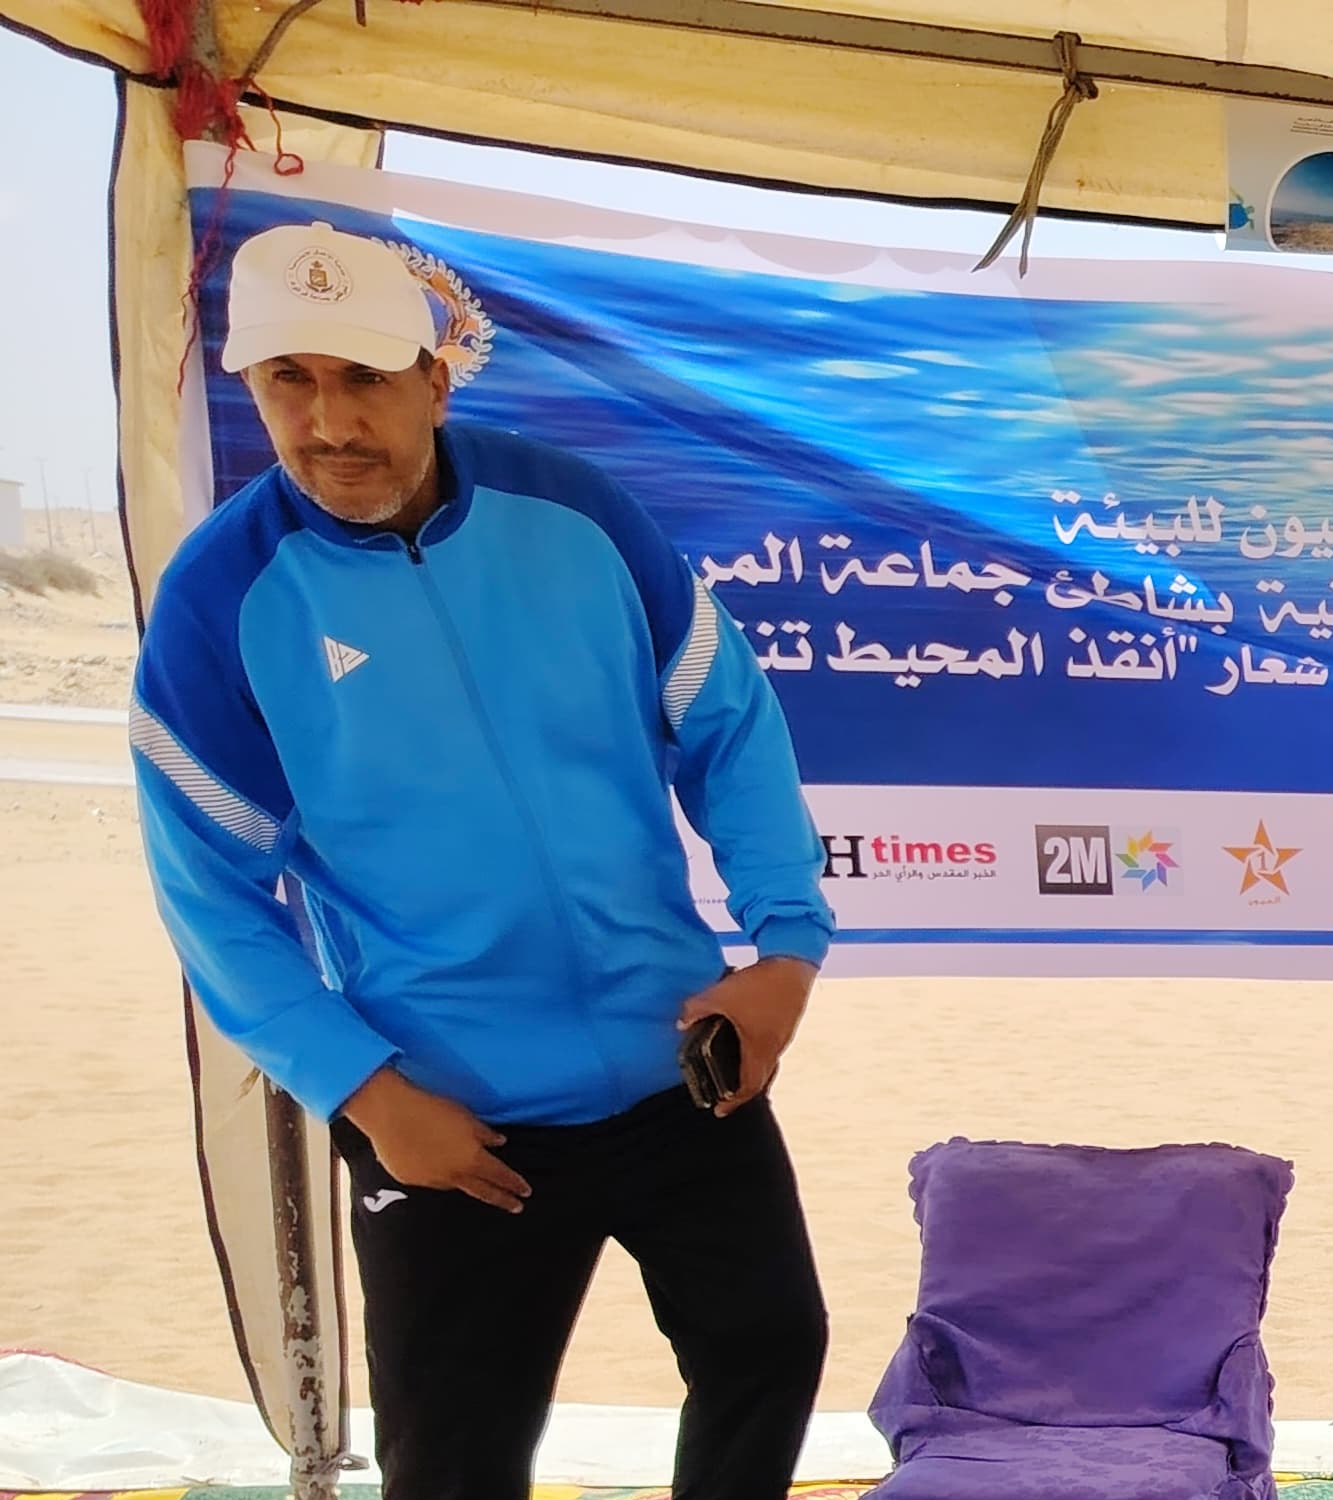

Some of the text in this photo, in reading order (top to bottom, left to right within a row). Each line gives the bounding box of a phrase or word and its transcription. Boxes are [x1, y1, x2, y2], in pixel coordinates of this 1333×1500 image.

[1050, 488, 1225, 554] للبيئة
[701, 531, 804, 590] المر
[819, 533, 1031, 606] جماعة
[1045, 569, 1235, 634] بشاطئ
[826, 621, 1043, 689] المحيط
[1206, 645, 1330, 696] شعار
[871, 834, 997, 864] times
[1043, 834, 1109, 885] 2M
